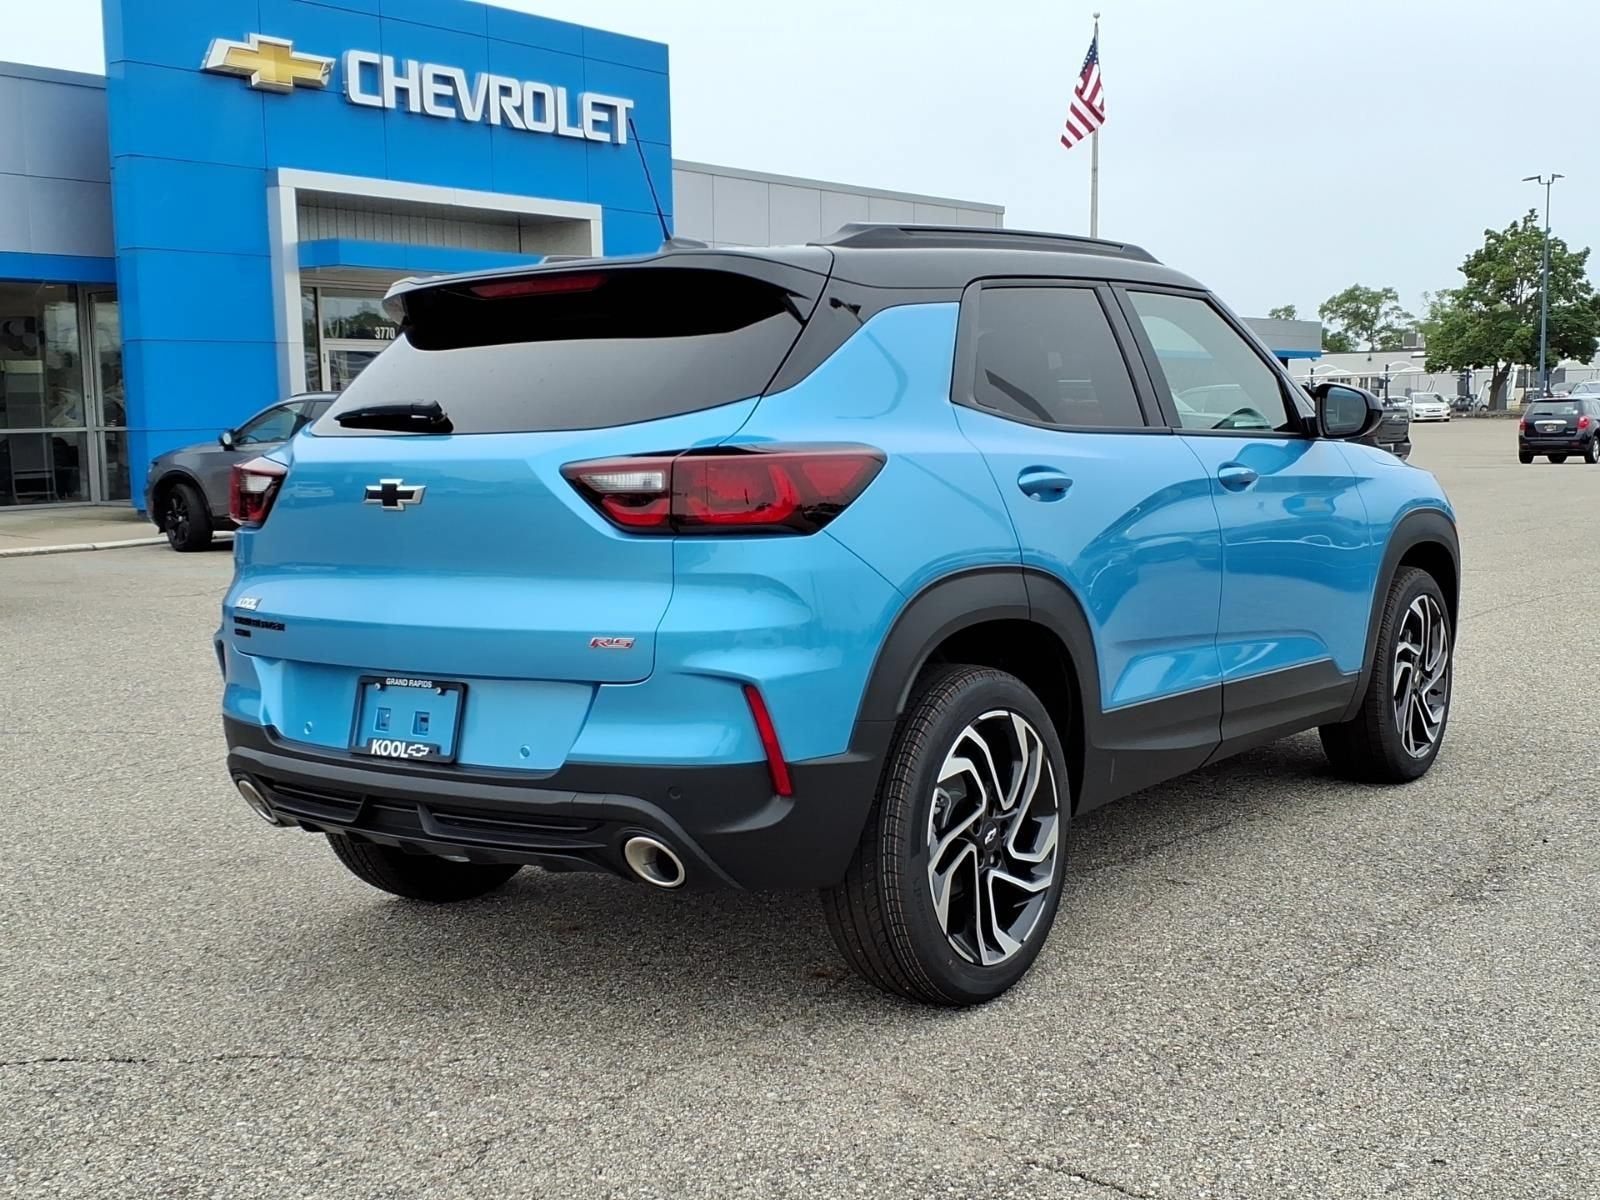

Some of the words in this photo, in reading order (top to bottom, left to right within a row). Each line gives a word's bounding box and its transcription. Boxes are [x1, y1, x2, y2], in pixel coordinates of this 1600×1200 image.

[343, 49, 634, 145] CHEVROLET
[375, 326, 395, 339] 3770
[590, 637, 635, 648] RS
[386, 678, 408, 686] GRAND
[409, 680, 432, 688] RAPIDS
[371, 739, 409, 758] KOOL
